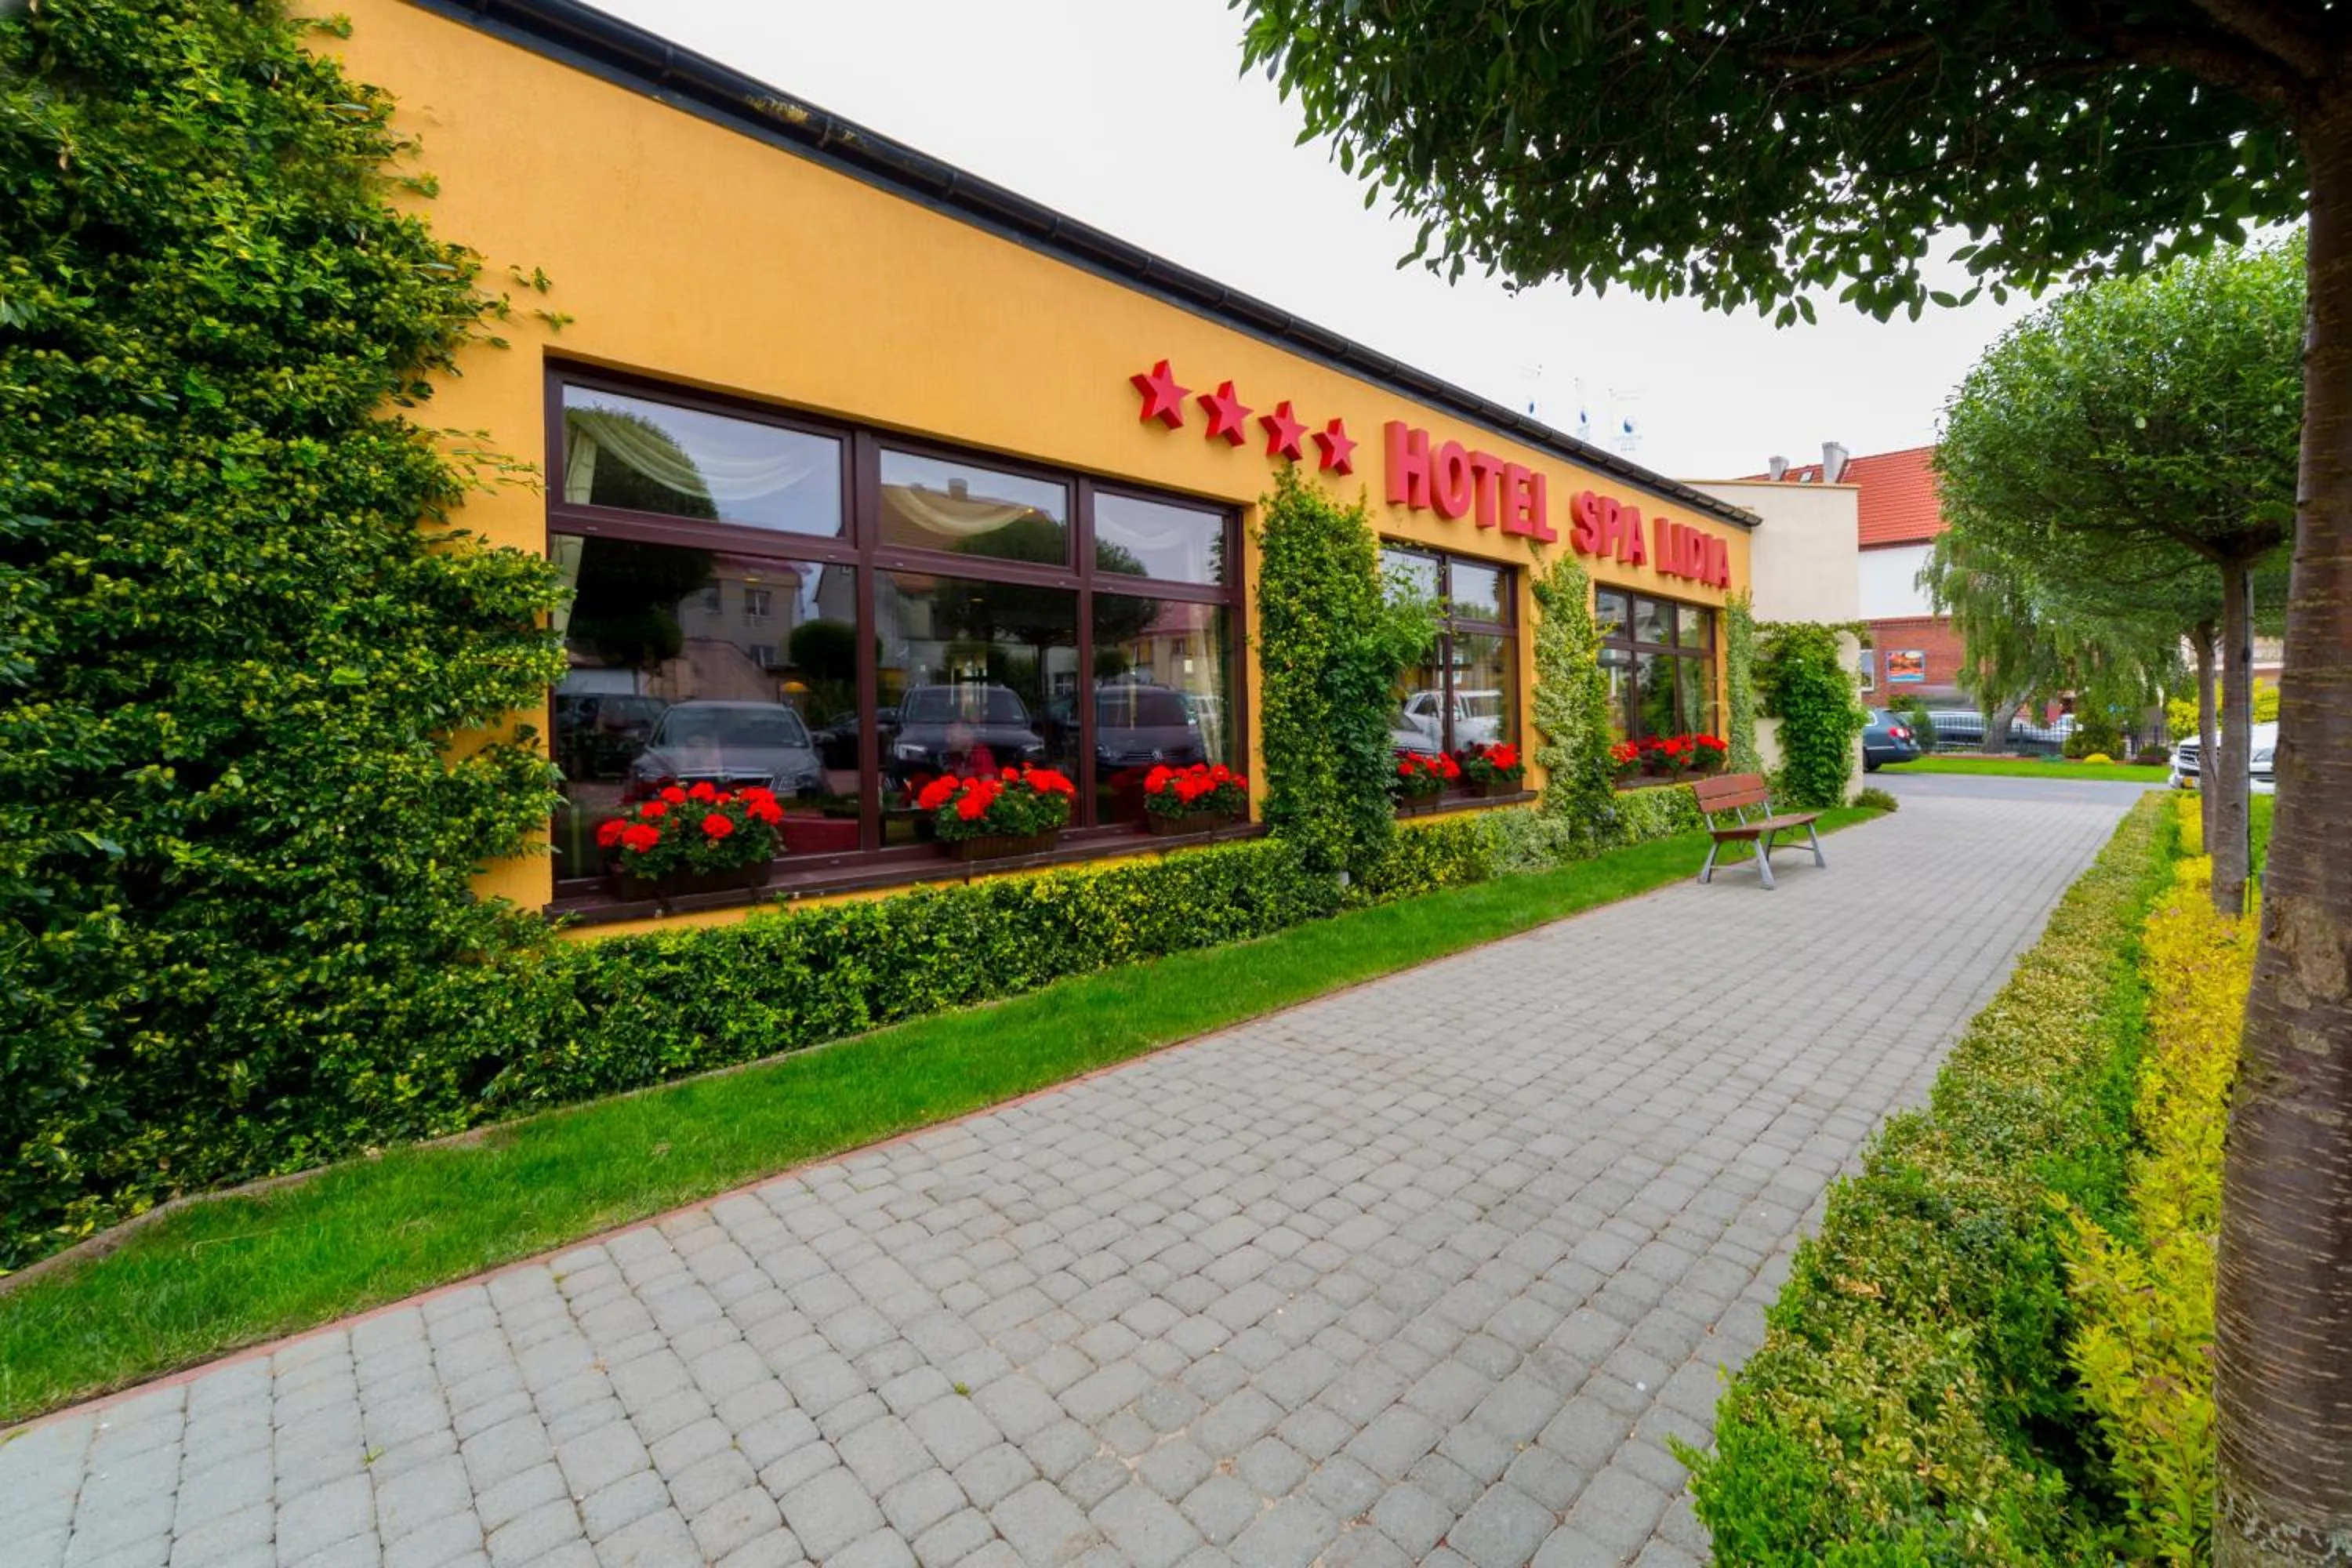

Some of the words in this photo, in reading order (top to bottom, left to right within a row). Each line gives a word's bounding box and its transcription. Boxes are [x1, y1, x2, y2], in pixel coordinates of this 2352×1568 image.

[1384, 420, 1557, 543] HOTEL
[1570, 490, 1646, 565] SPA
[1654, 517, 1731, 588] LIDIA
